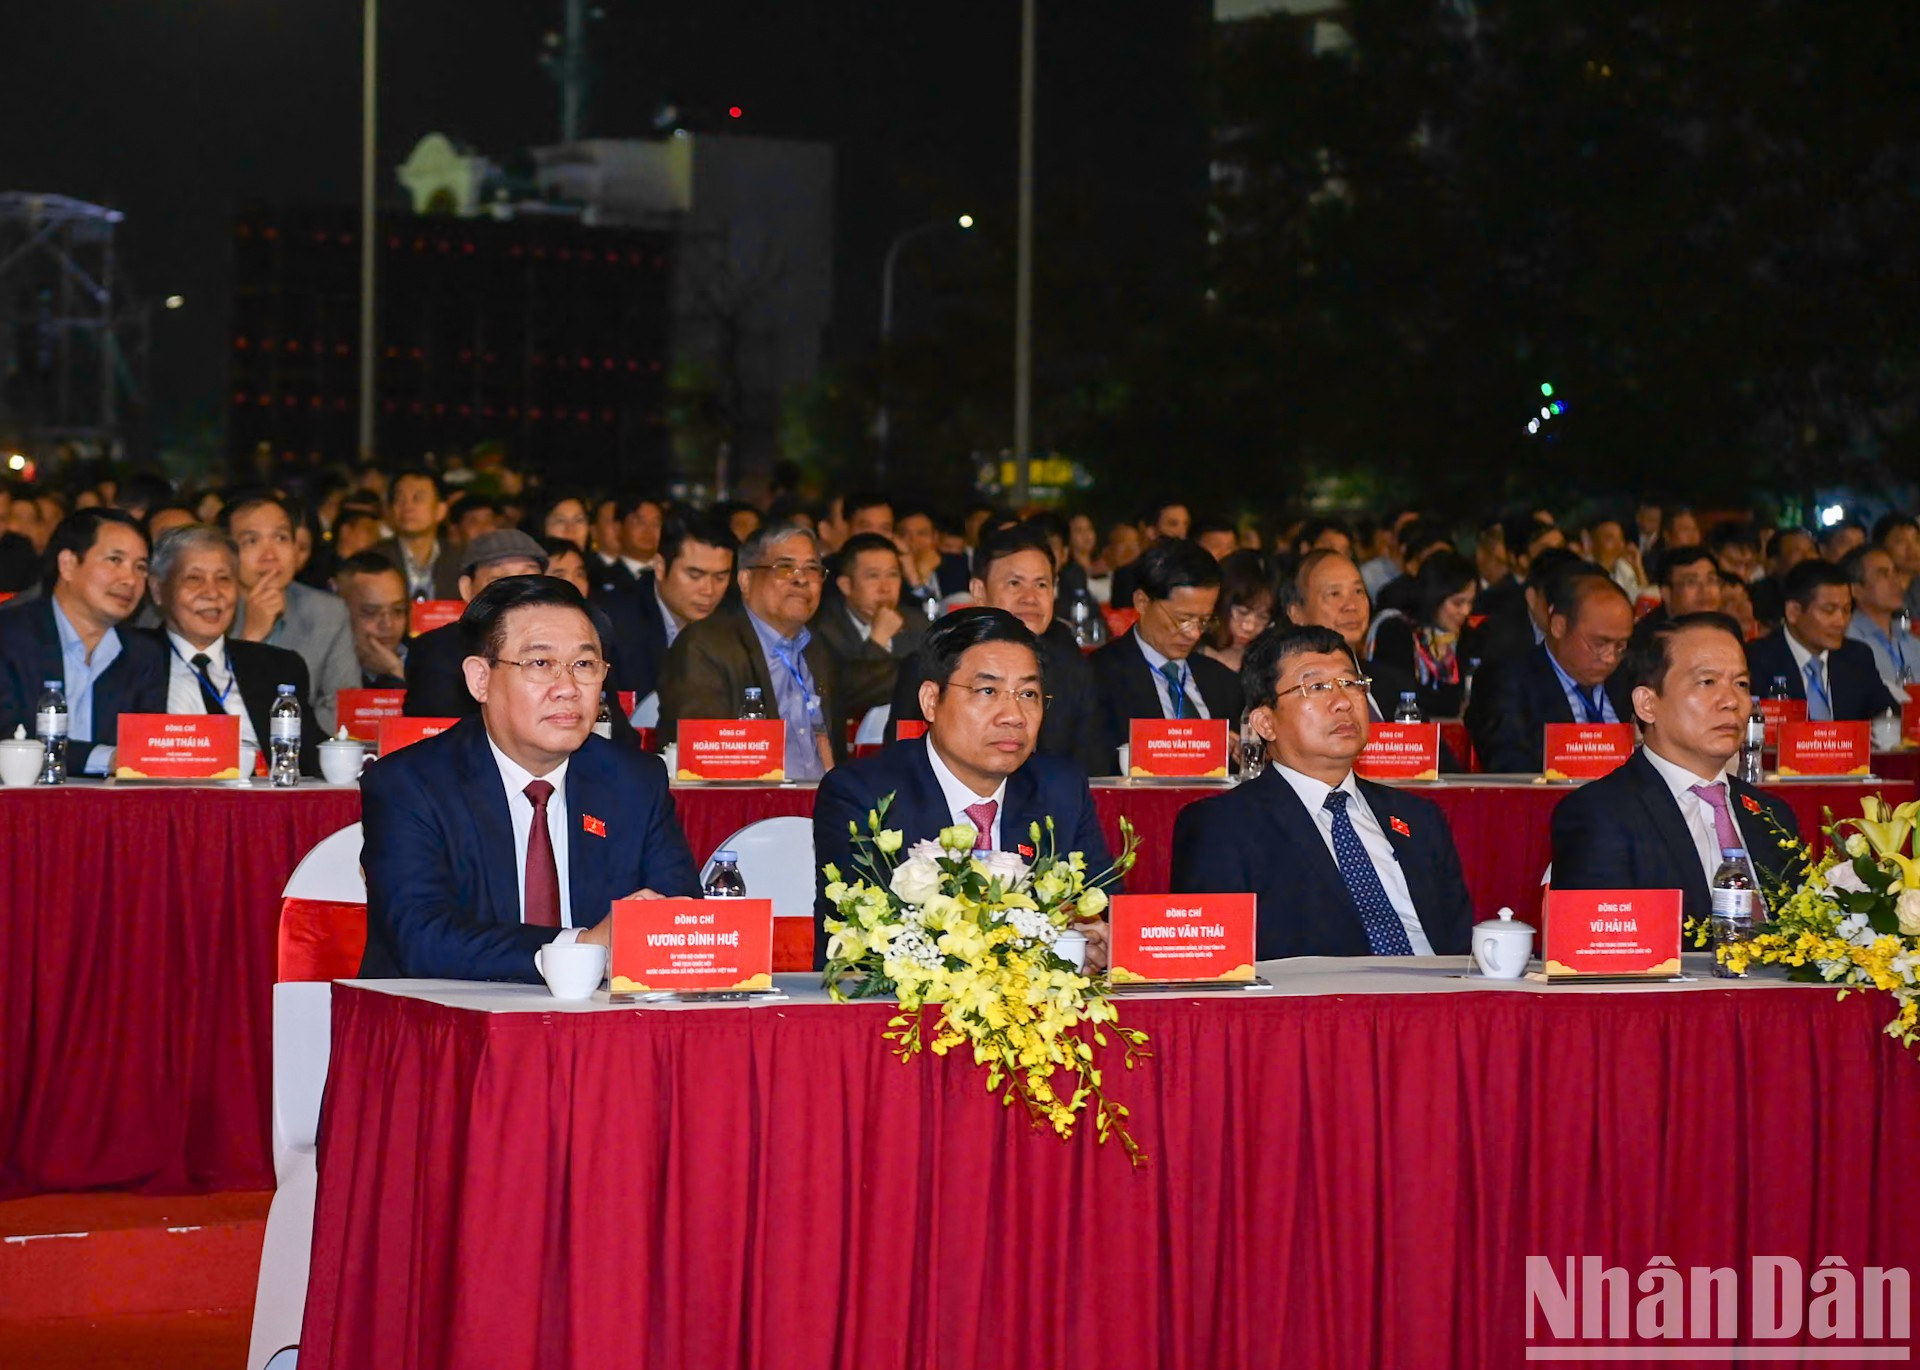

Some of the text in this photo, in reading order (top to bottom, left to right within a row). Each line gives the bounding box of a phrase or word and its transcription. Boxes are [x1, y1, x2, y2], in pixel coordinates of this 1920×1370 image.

[148, 736, 210, 749] PHẠM THÁI HÀ
[693, 740, 770, 751] HOÀNG THANH KHIẾT
[1148, 739, 1211, 750] DƯƠNG VĂN TRỌNG
[1363, 742, 1384, 751] UYỄN
[1405, 743, 1424, 752] KHOA
[1584, 742, 1597, 752] VĂN
[1598, 743, 1615, 752] KHOA
[1796, 739, 1853, 750] NGUYỄN VĂN LINH
[1166, 907, 1202, 918] ĐỒNG CHÍ
[1598, 902, 1632, 912] ĐỒNG CHÍ
[674, 913, 714, 925] ĐỒNG CHÍ
[1590, 918, 1637, 932] VŨ HẢI HÀ
[1141, 924, 1224, 939] DƯƠNG VĂN THÁI
[647, 931, 739, 948] VƯƠNG ĐÌNH HUỆ
